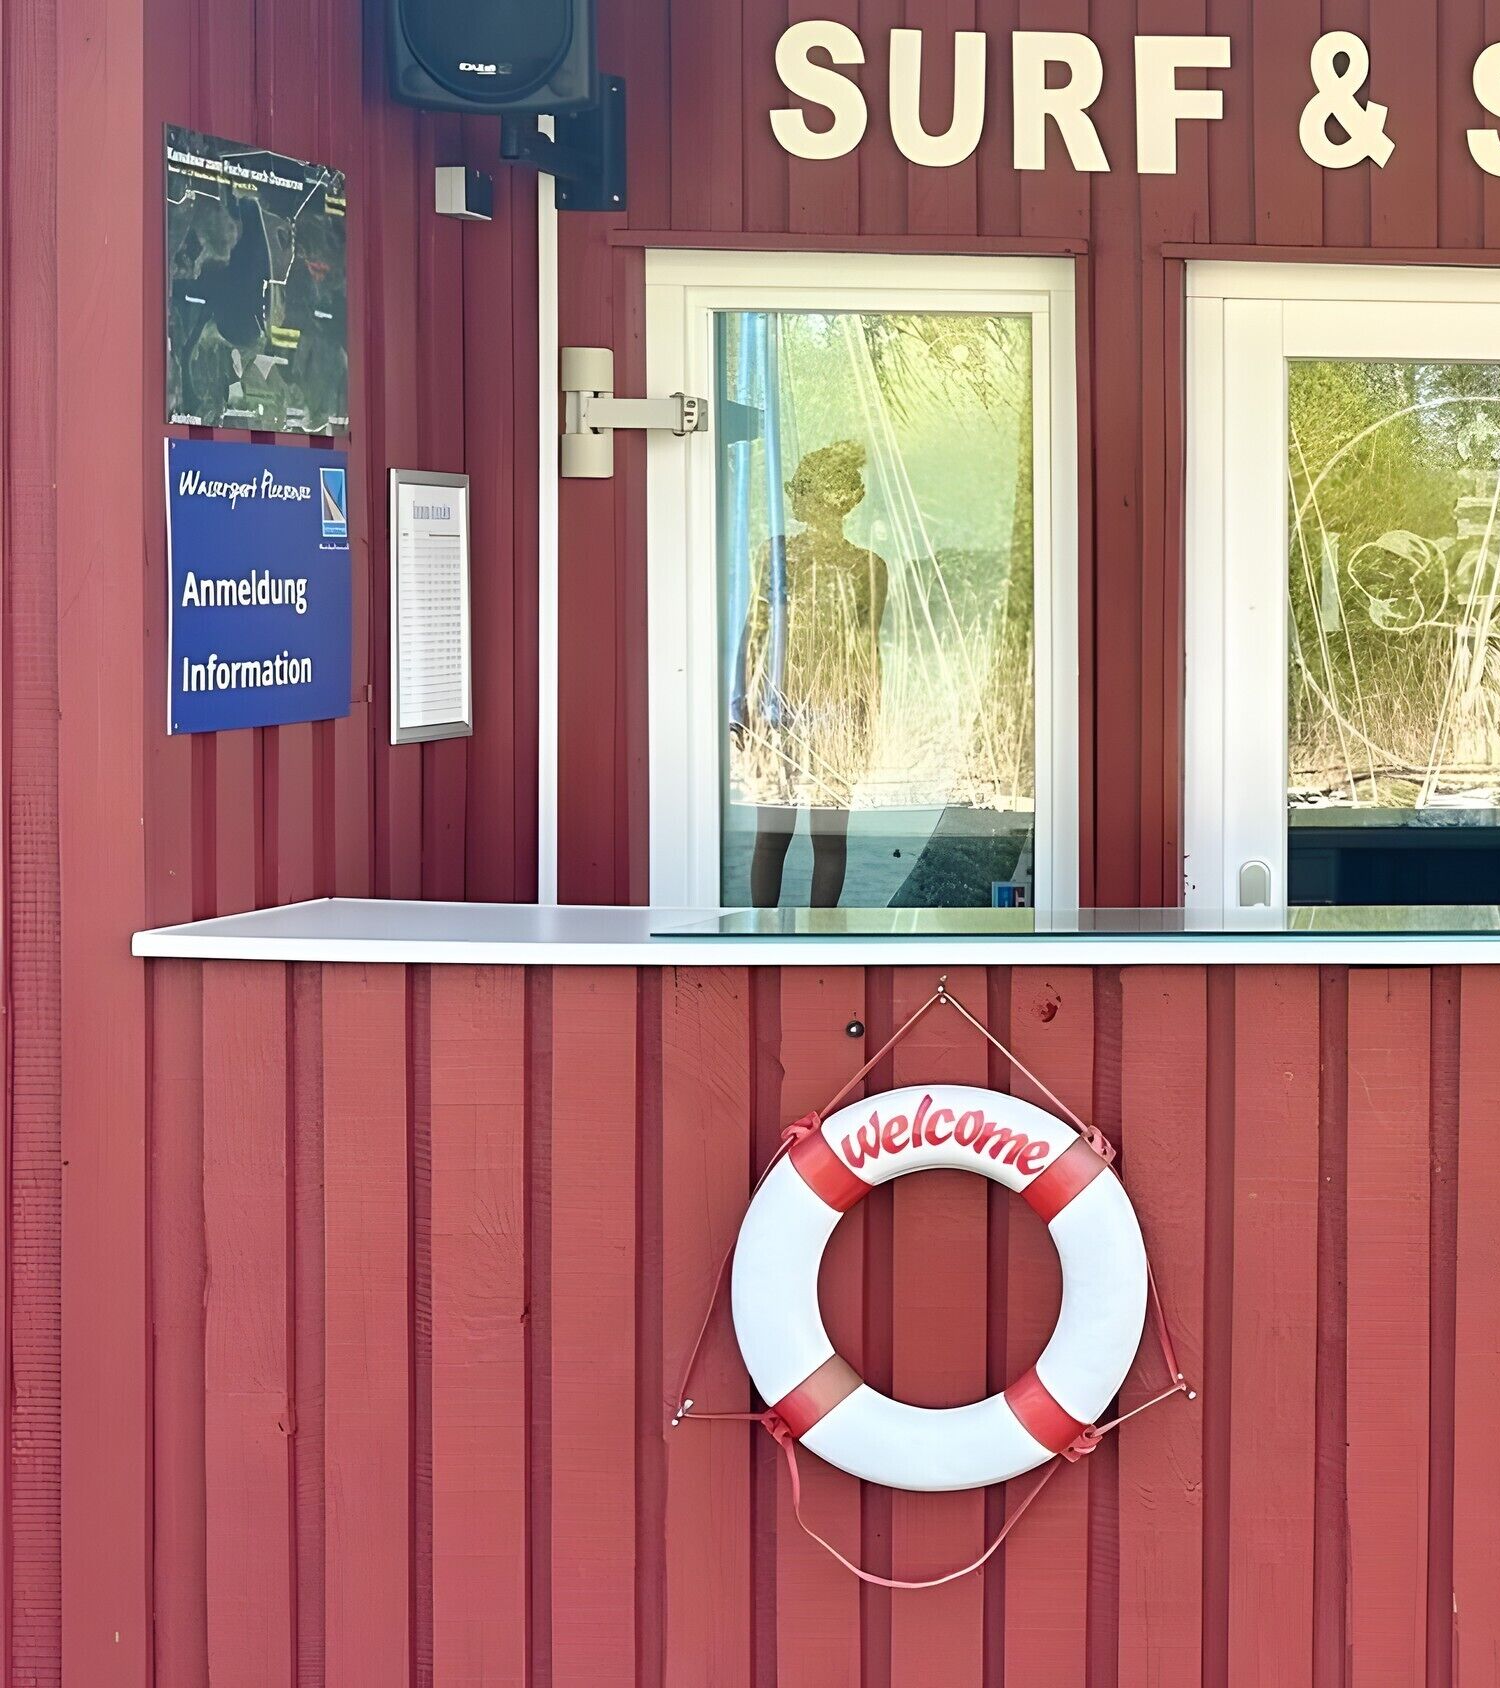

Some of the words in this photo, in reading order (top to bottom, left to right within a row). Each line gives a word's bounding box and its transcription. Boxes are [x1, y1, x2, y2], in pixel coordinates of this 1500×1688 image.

[769, 20, 1232, 175] SURF
[1299, 31, 1396, 170] &
[182, 570, 308, 613] Anmeldung
[182, 651, 312, 692] Information
